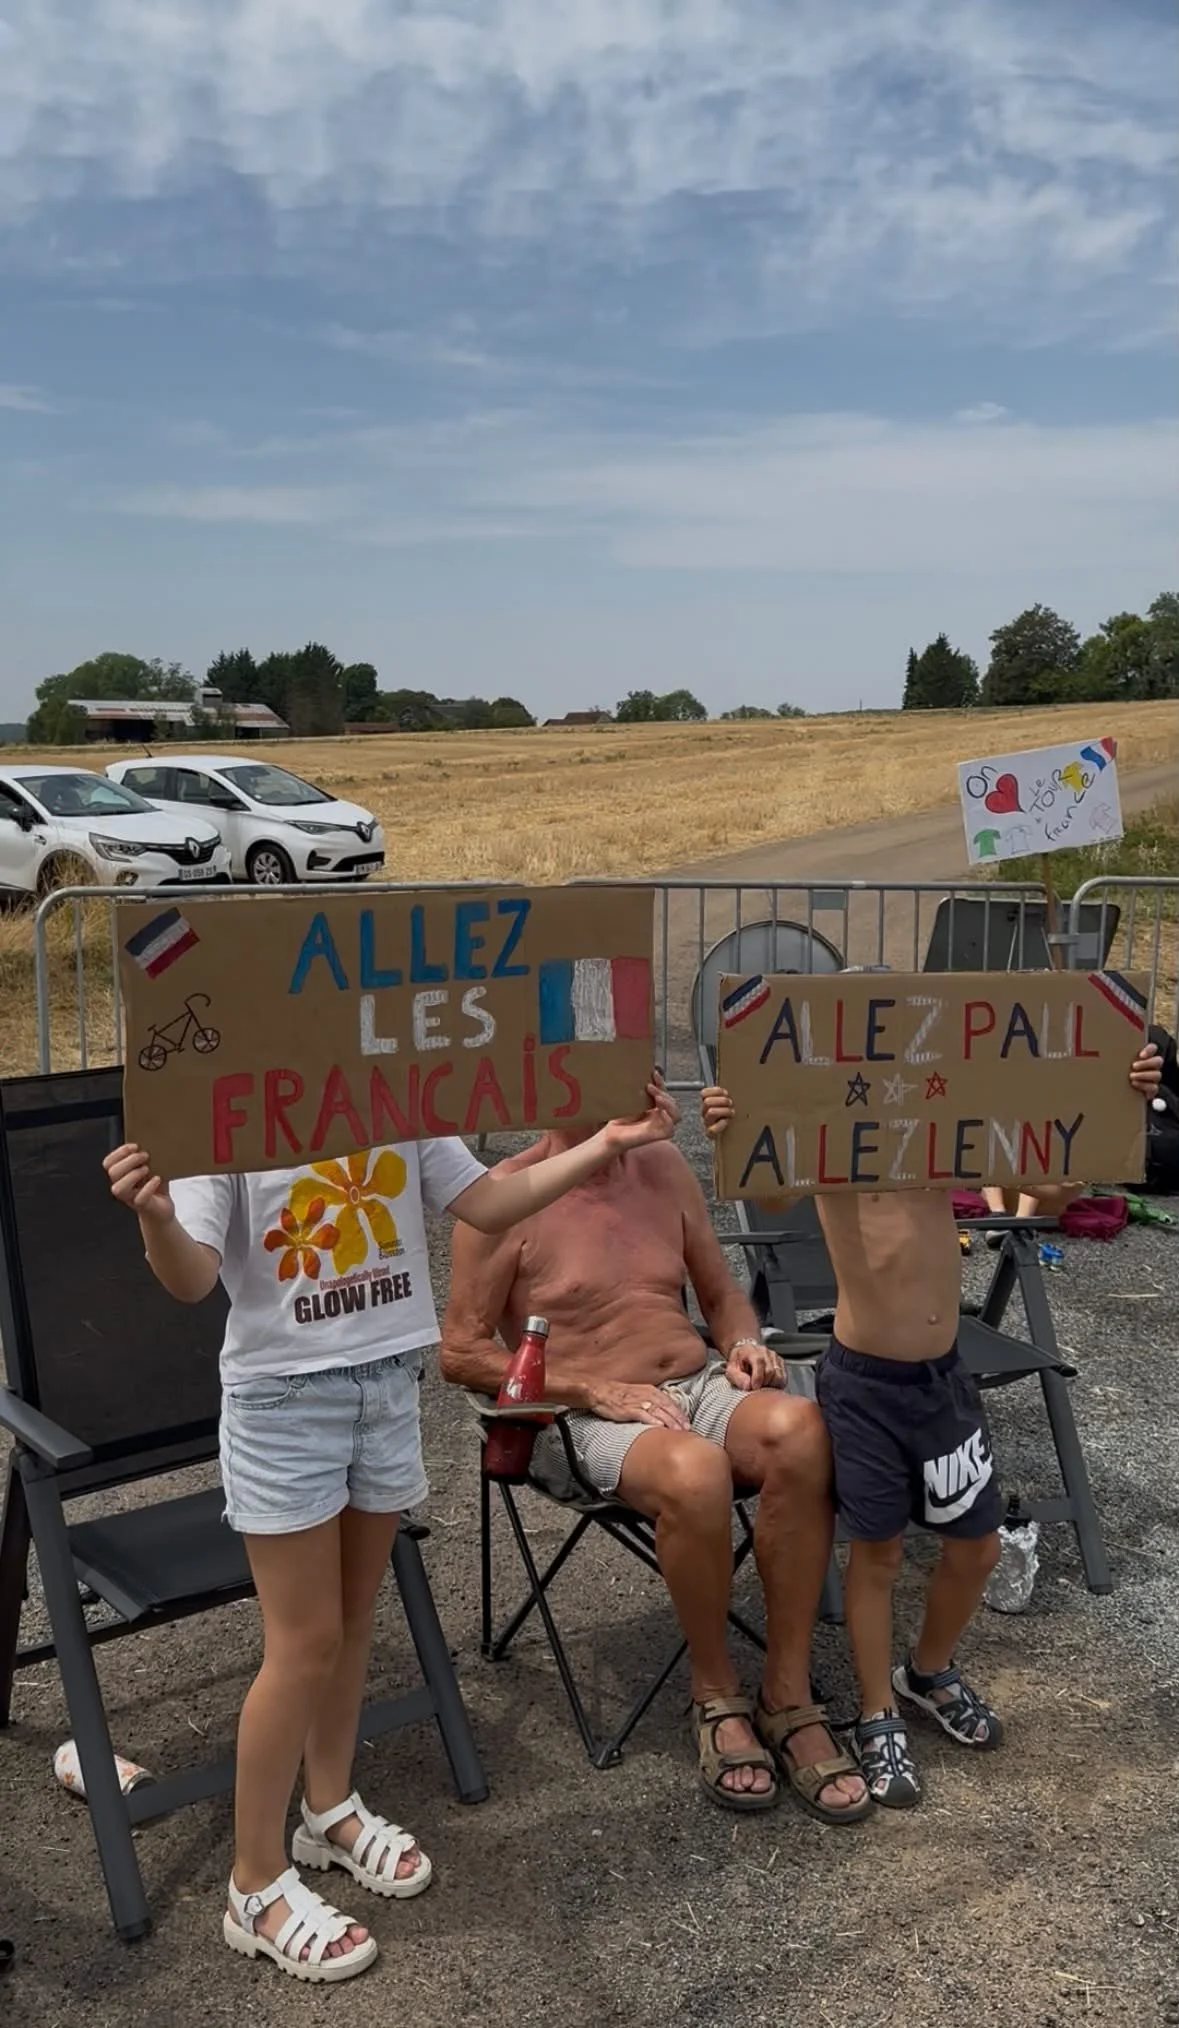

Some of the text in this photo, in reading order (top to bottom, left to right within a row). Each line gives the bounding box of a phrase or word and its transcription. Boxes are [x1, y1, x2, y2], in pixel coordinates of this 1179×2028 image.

[966, 765, 997, 799] On
[1029, 778, 1046, 796] Le
[288, 898, 531, 994] ALLEZ
[359, 986, 497, 1057] LES
[759, 996, 947, 1067] ALLEZ
[739, 1113, 1085, 1189] ALLEZ LENNY
[294, 1284, 365, 1324] GLOW
[370, 1272, 413, 1308] FREE
[923, 1427, 991, 1500] NIKE
